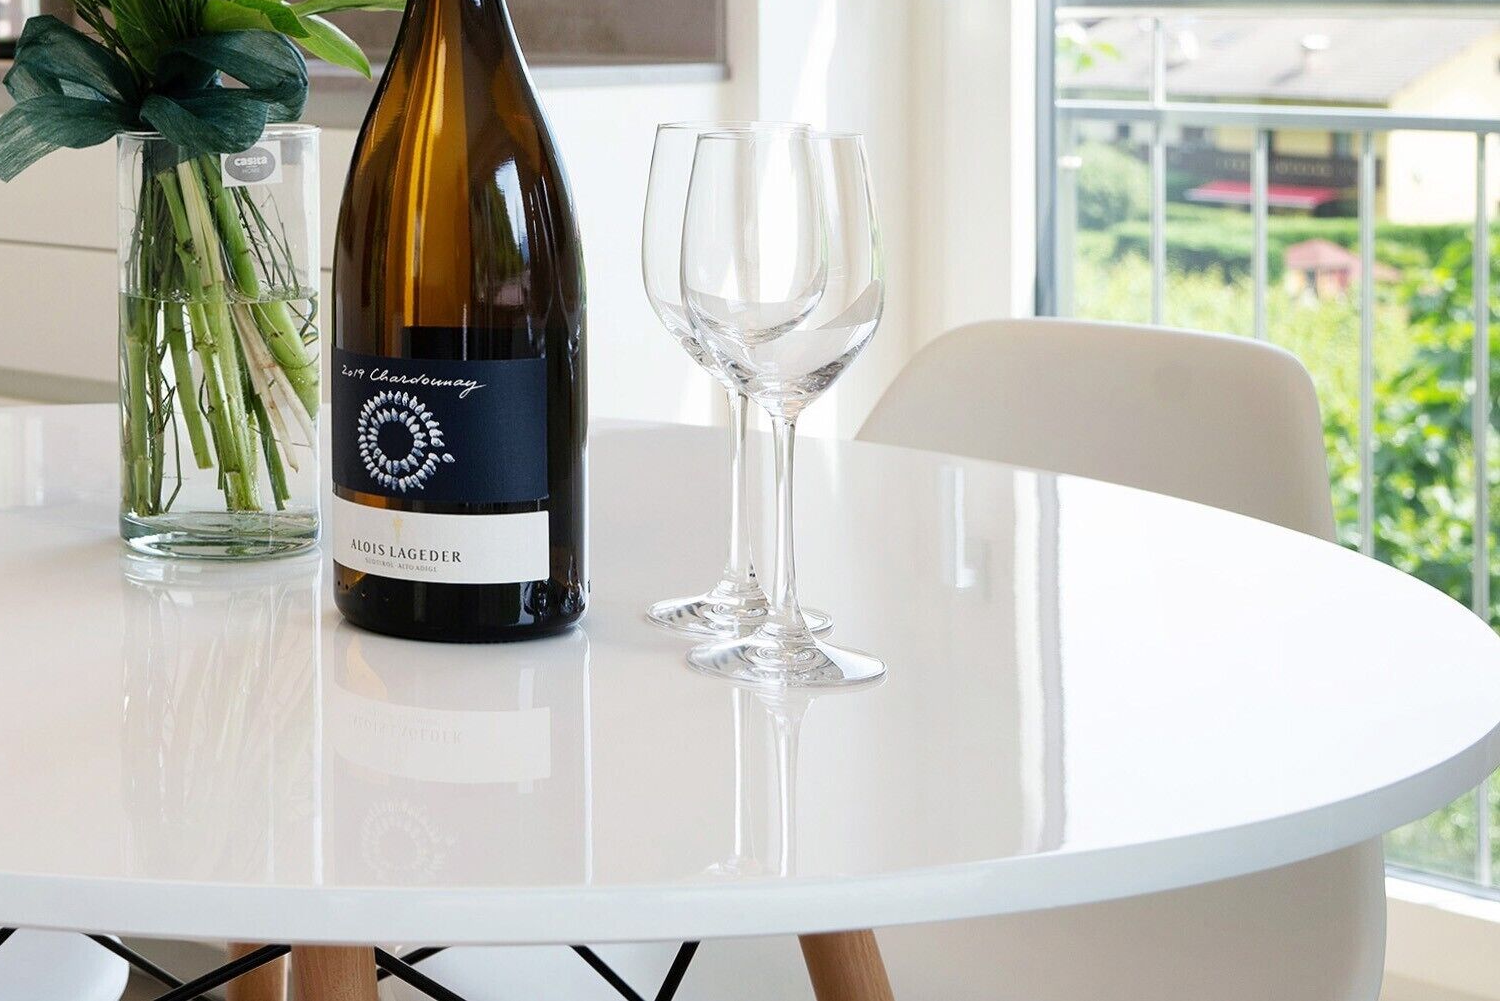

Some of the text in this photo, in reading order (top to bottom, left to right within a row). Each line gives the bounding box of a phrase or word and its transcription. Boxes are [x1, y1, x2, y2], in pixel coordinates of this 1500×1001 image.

[341, 364, 487, 399] 2019 Chardonnay
[351, 539, 462, 563] ALOIS LAGEDER
